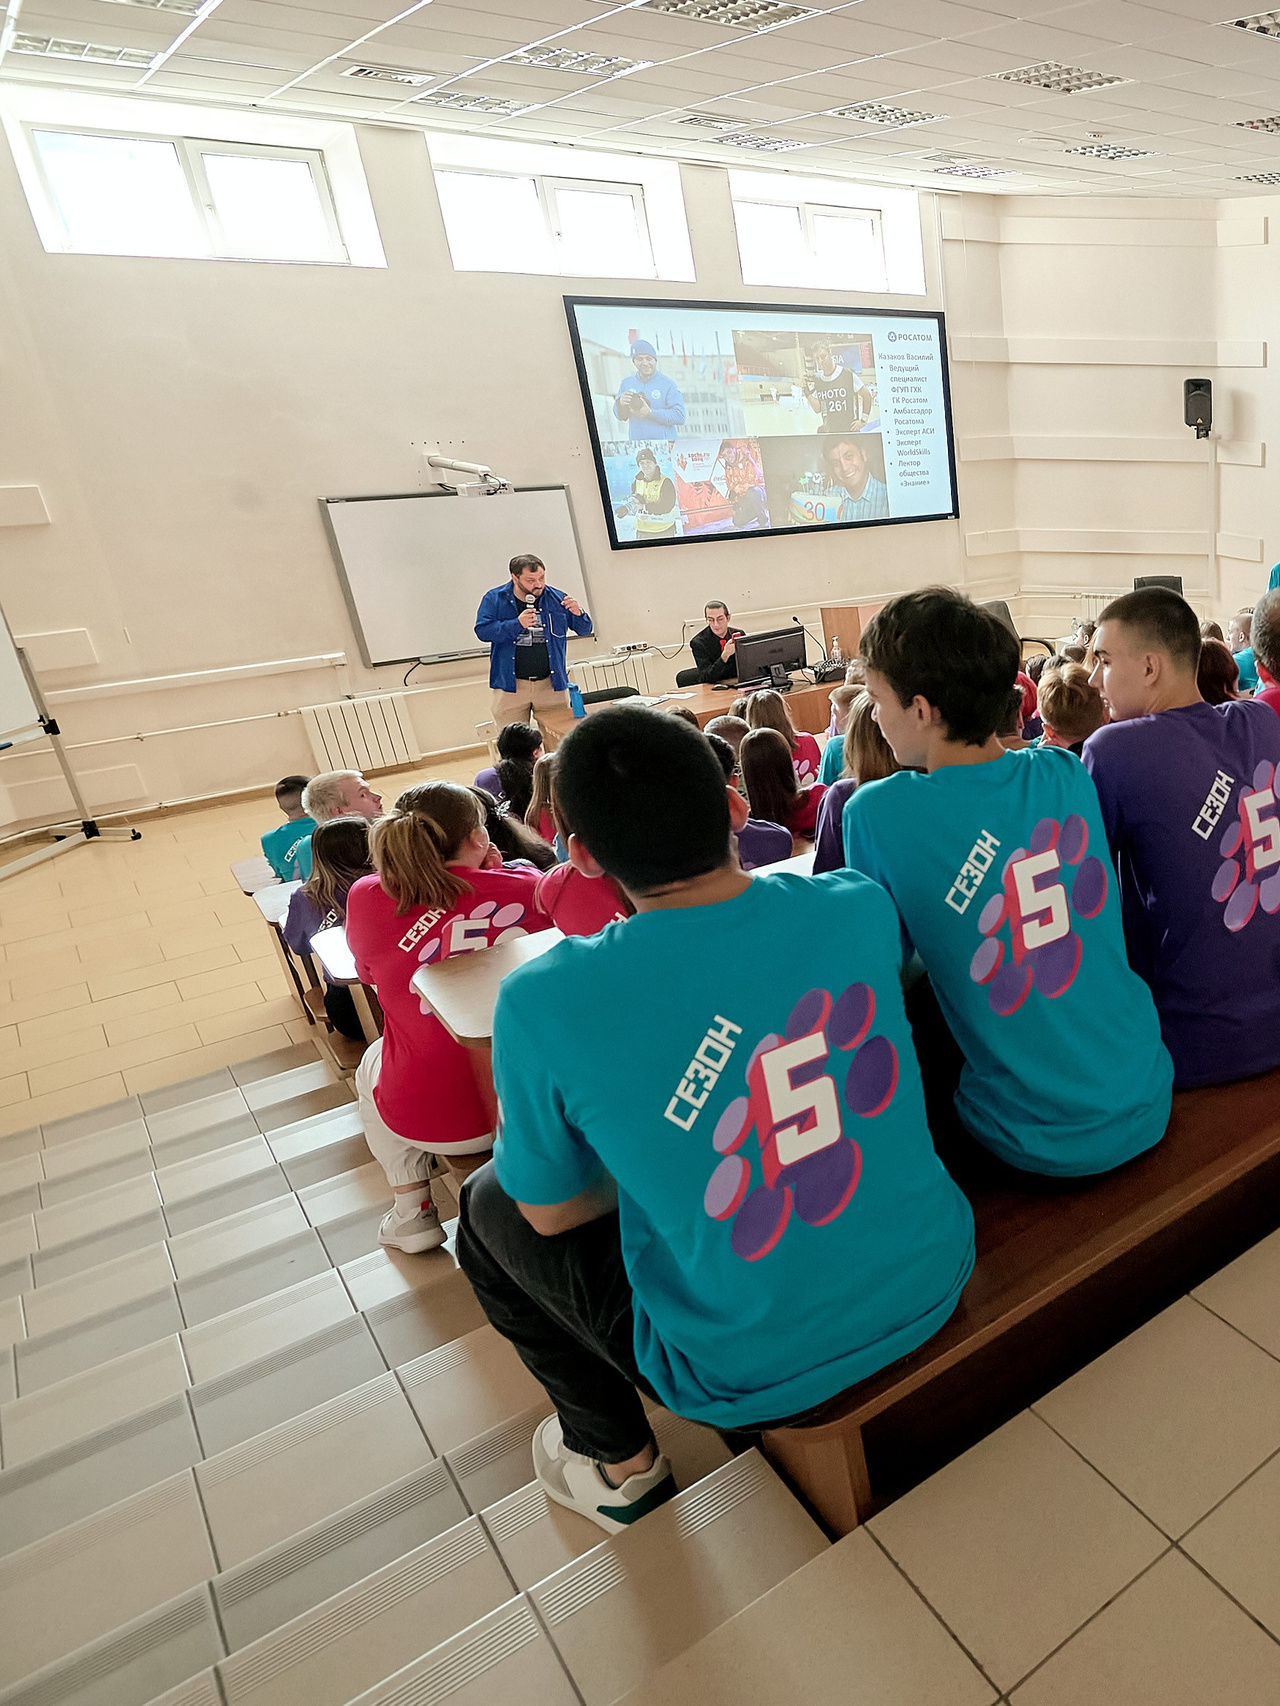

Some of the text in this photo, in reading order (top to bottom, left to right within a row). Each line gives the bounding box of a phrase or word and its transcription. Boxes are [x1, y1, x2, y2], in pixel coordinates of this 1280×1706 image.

[898, 333, 932, 342] РОСАТОМ
[878, 353, 934, 361] Казаков Василий
[889, 364, 919, 373] Ведущий
[901, 396, 928, 404] Росатом
[829, 400, 847, 412] 261
[893, 407, 932, 416] Амбассадор
[895, 428, 921, 437] Эксперт
[896, 439, 922, 447] Эксперт
[897, 449, 931, 457] WorldSkills
[898, 460, 921, 468] Лектор
[899, 469, 929, 477] общества
[804, 502, 826, 521] 30
[1192, 769, 1235, 840] СЕЗОН
[944, 829, 1002, 915] СЕЗОН
[1012, 849, 1070, 950] 5
[663, 1013, 744, 1133] СЕЗОН
[760, 1031, 843, 1167] 5
